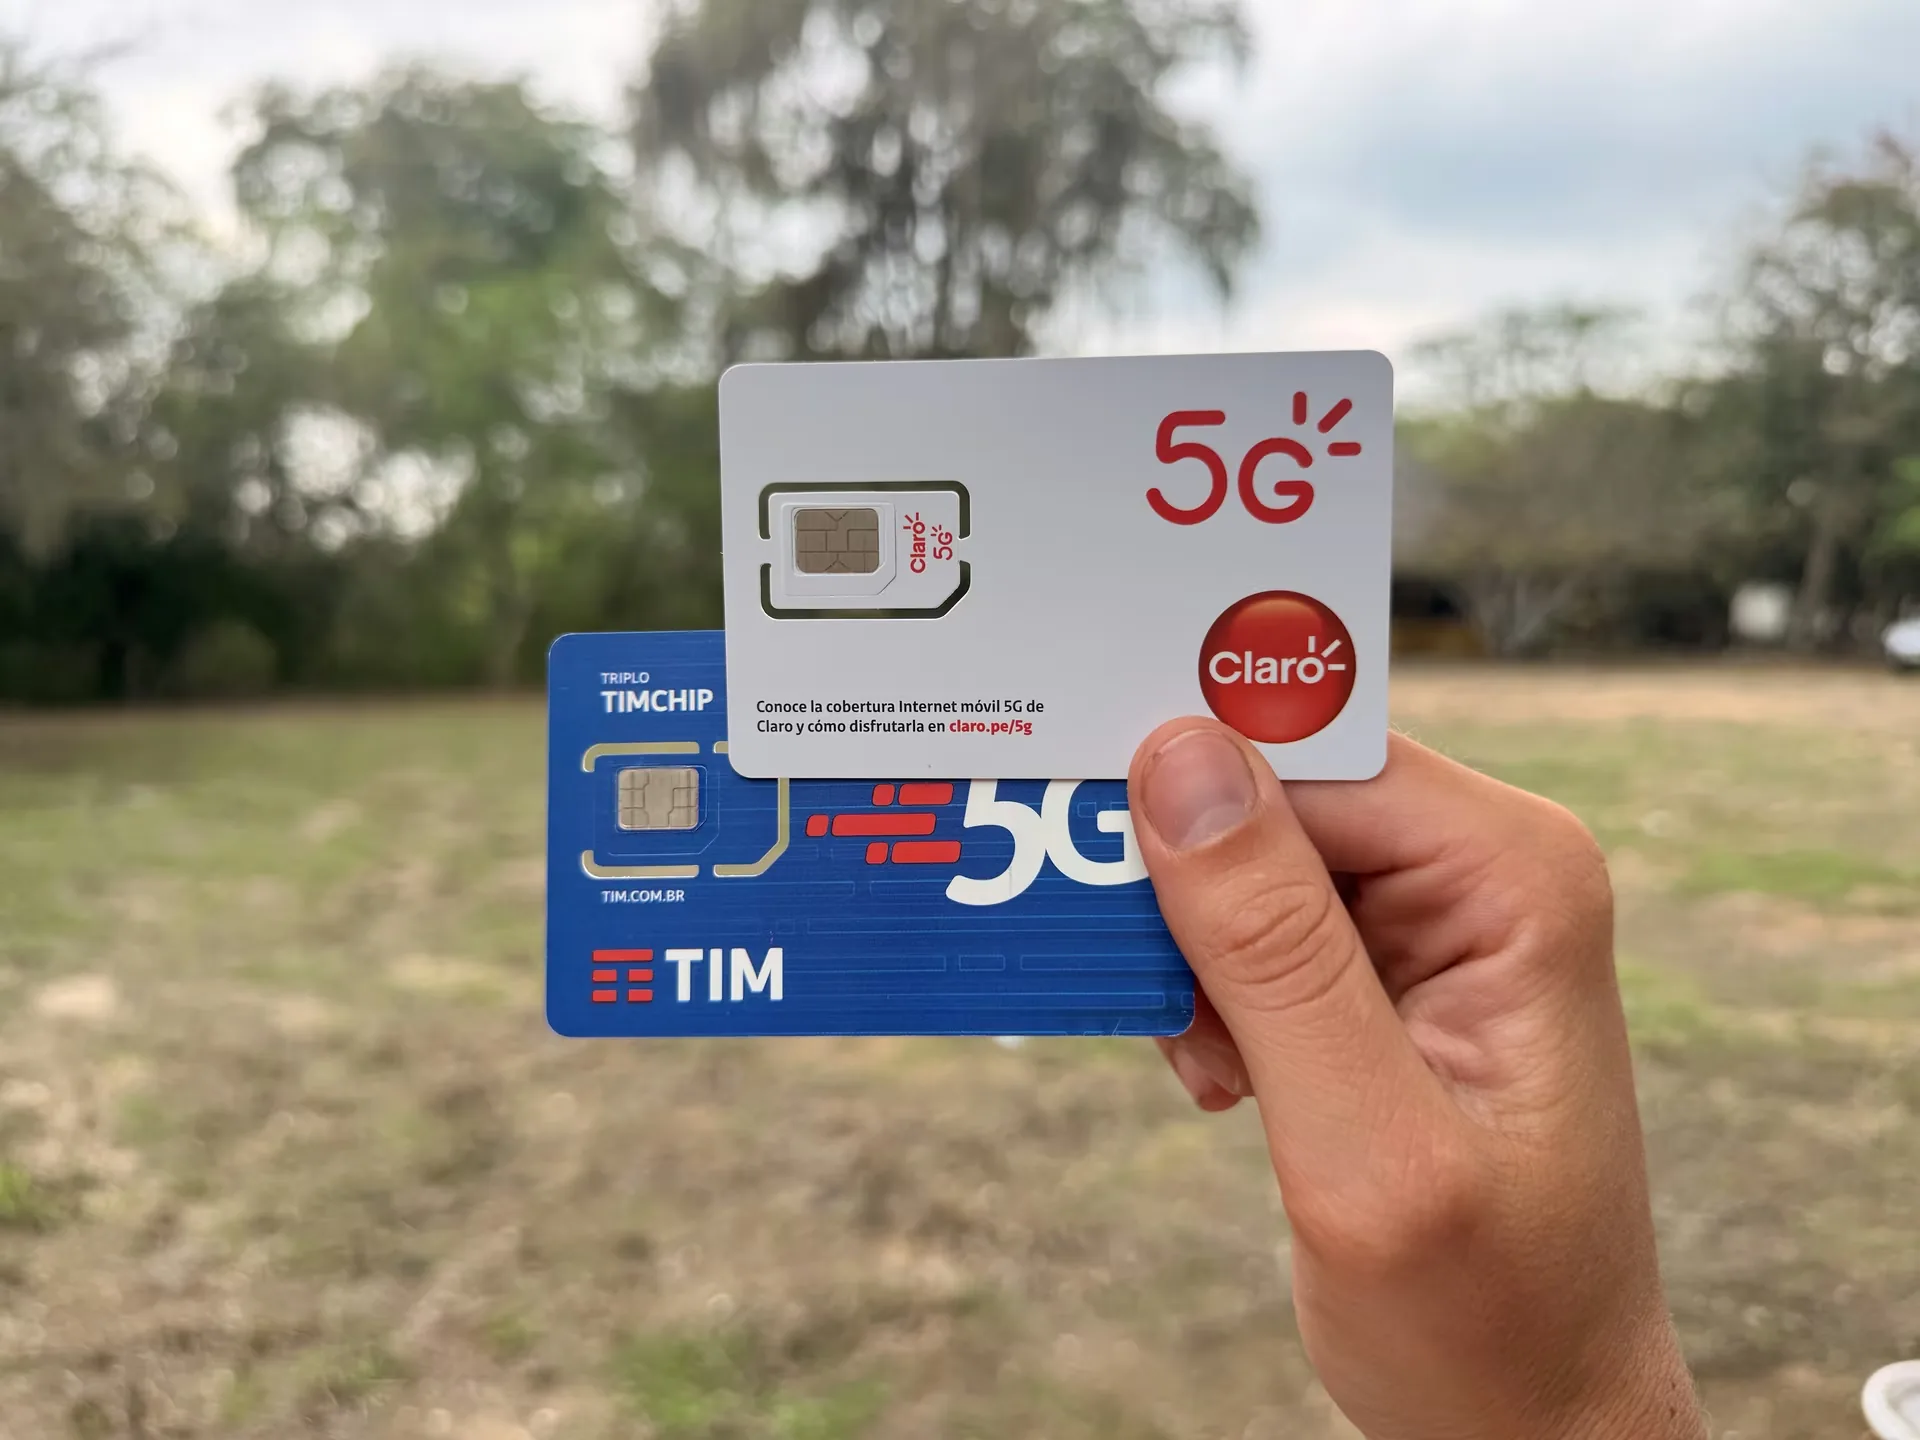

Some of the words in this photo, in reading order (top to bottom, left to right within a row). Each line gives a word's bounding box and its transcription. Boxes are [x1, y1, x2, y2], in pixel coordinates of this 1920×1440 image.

[1145, 409, 1315, 526] 5G
[909, 520, 927, 574] Claro
[932, 530, 954, 561] 5G
[600, 671, 650, 685] TRIPLO
[1207, 649, 1326, 686] Claro
[600, 688, 714, 714] TIMCHIP
[756, 699, 807, 713] Conoce
[810, 699, 823, 713] la
[826, 699, 896, 713] cobertura
[898, 699, 958, 713] Internet
[960, 699, 1001, 713] móvil
[1003, 699, 1023, 713] 5G
[1026, 699, 1045, 713] de
[756, 719, 794, 733] Claro
[795, 722, 804, 735] y
[807, 719, 847, 733] cómo
[849, 719, 925, 733] disfrutarla
[927, 722, 946, 733] en
[949, 718, 1033, 736] claro.pe/5g
[944, 778, 1151, 907] 5G
[600, 889, 686, 904] TIM.COM.BR
[664, 947, 784, 1003] TIM
